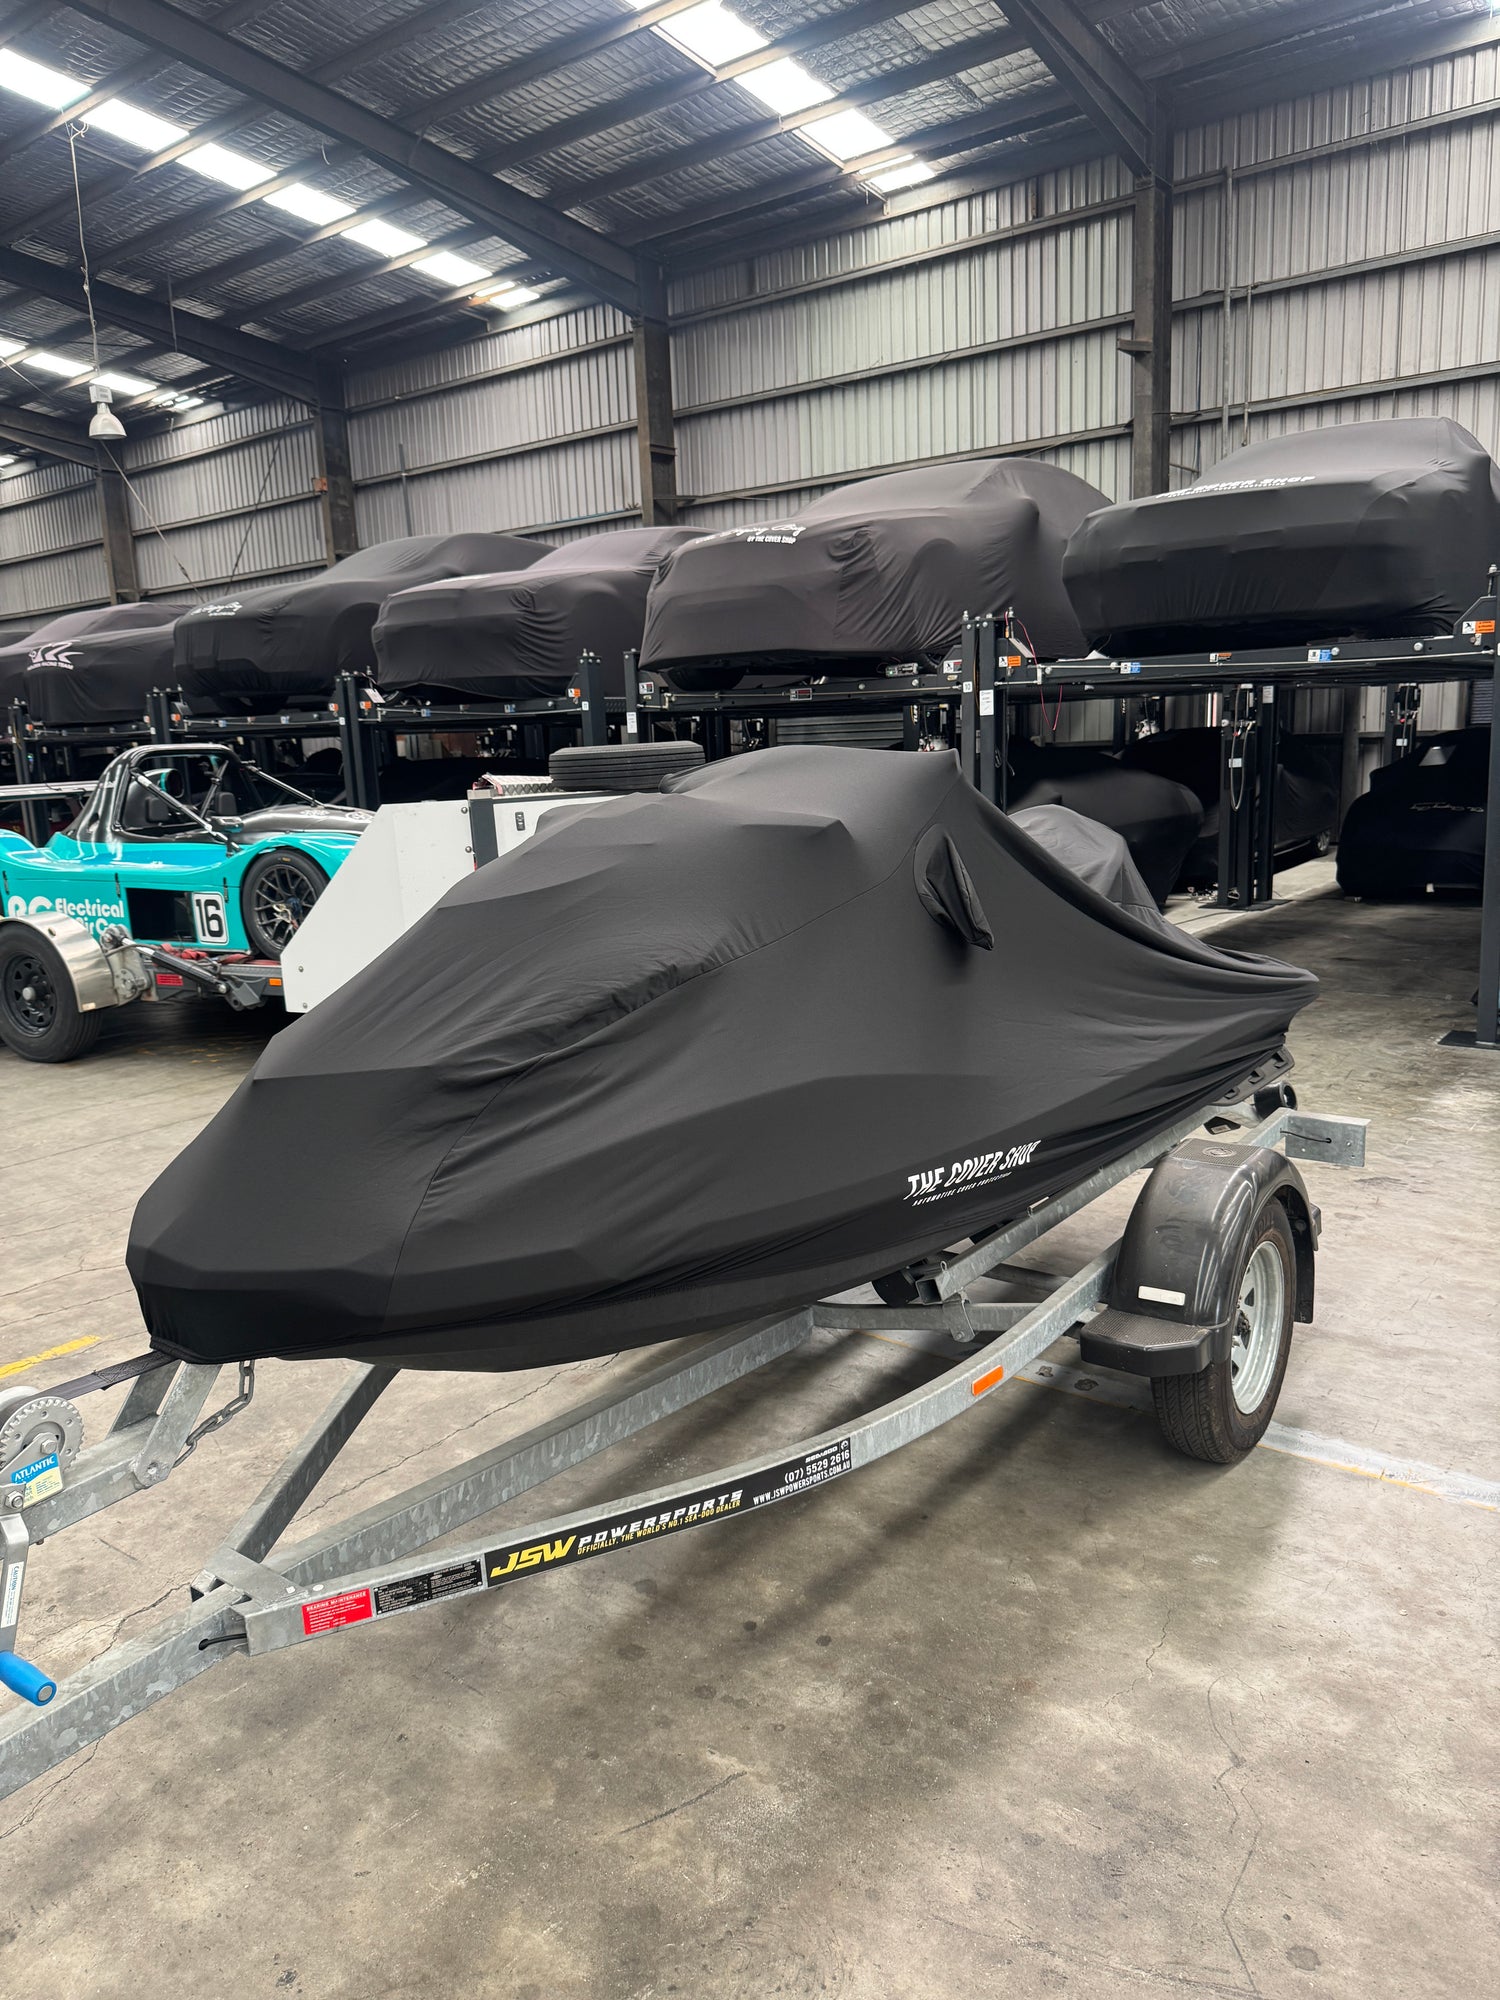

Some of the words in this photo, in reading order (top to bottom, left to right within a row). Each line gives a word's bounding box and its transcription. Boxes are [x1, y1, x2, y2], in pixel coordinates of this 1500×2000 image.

[765, 535, 781, 544] COVER
[55, 896, 125, 919] Electrical
[194, 898, 224, 939] 16
[902, 1166, 946, 1201] THE
[943, 1150, 1004, 1188] COVER
[998, 1139, 1042, 1171] SHOP
[911, 1188, 957, 1207] AUTOMOTIVE
[14, 1454, 57, 1483] ATLANTIC
[752, 1459, 851, 1506] WWW.JSWPOWERSPORTS.COM.AU
[784, 1467, 804, 1484] (07)
[805, 1458, 829, 1476] 5529
[829, 1449, 851, 1466] 2616
[489, 1535, 578, 1578] JSW
[578, 1489, 744, 1548] POWERSPORTS
[621, 1532, 635, 1543] THE
[636, 1521, 667, 1538] WORLD'S
[668, 1518, 684, 1529] NO.1
[684, 1508, 715, 1522] SEA-DOO
[715, 1499, 741, 1514] DEALER
